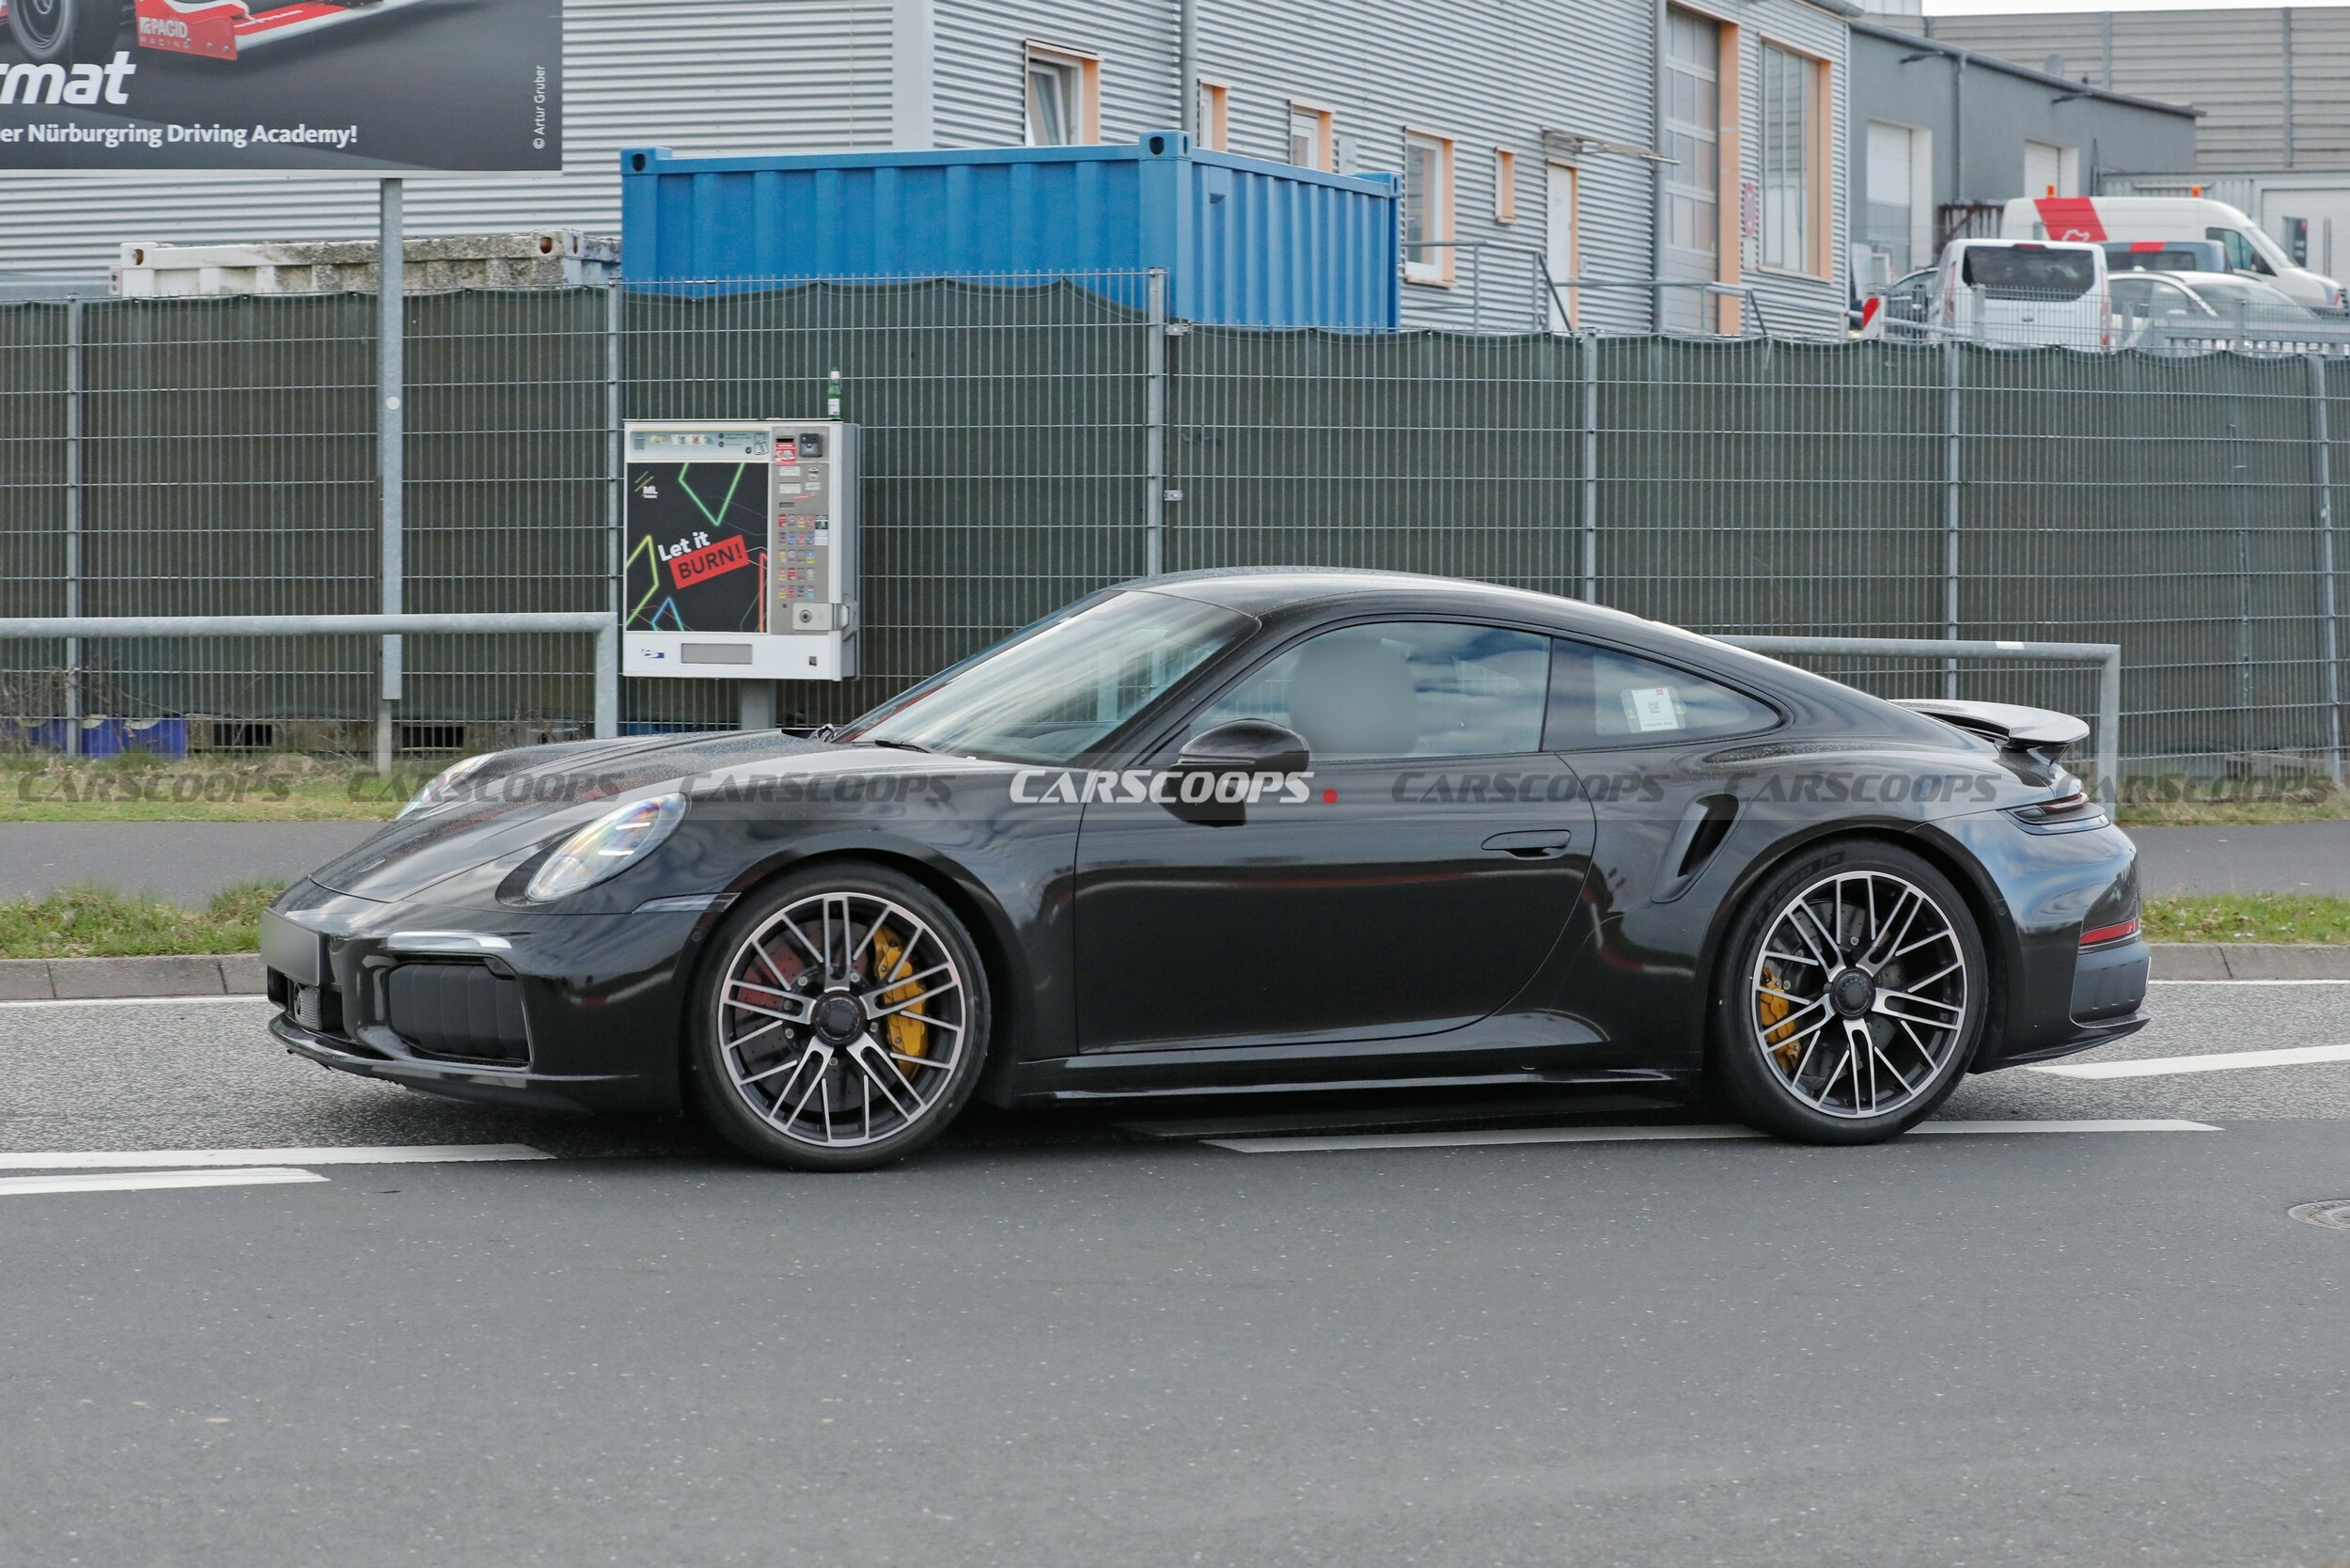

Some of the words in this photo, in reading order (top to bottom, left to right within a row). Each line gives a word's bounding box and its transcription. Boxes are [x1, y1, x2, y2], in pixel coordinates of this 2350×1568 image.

[150, 18, 188, 38] PAGID
[533, 65, 545, 103] Gruber
[534, 106, 545, 135] Artur
[28, 123, 163, 148] Nürburgring
[167, 123, 247, 149] Driving
[251, 123, 357, 149] Academy!
[658, 539, 692, 561] Let
[693, 531, 711, 549] it
[678, 543, 743, 579] BURN!
